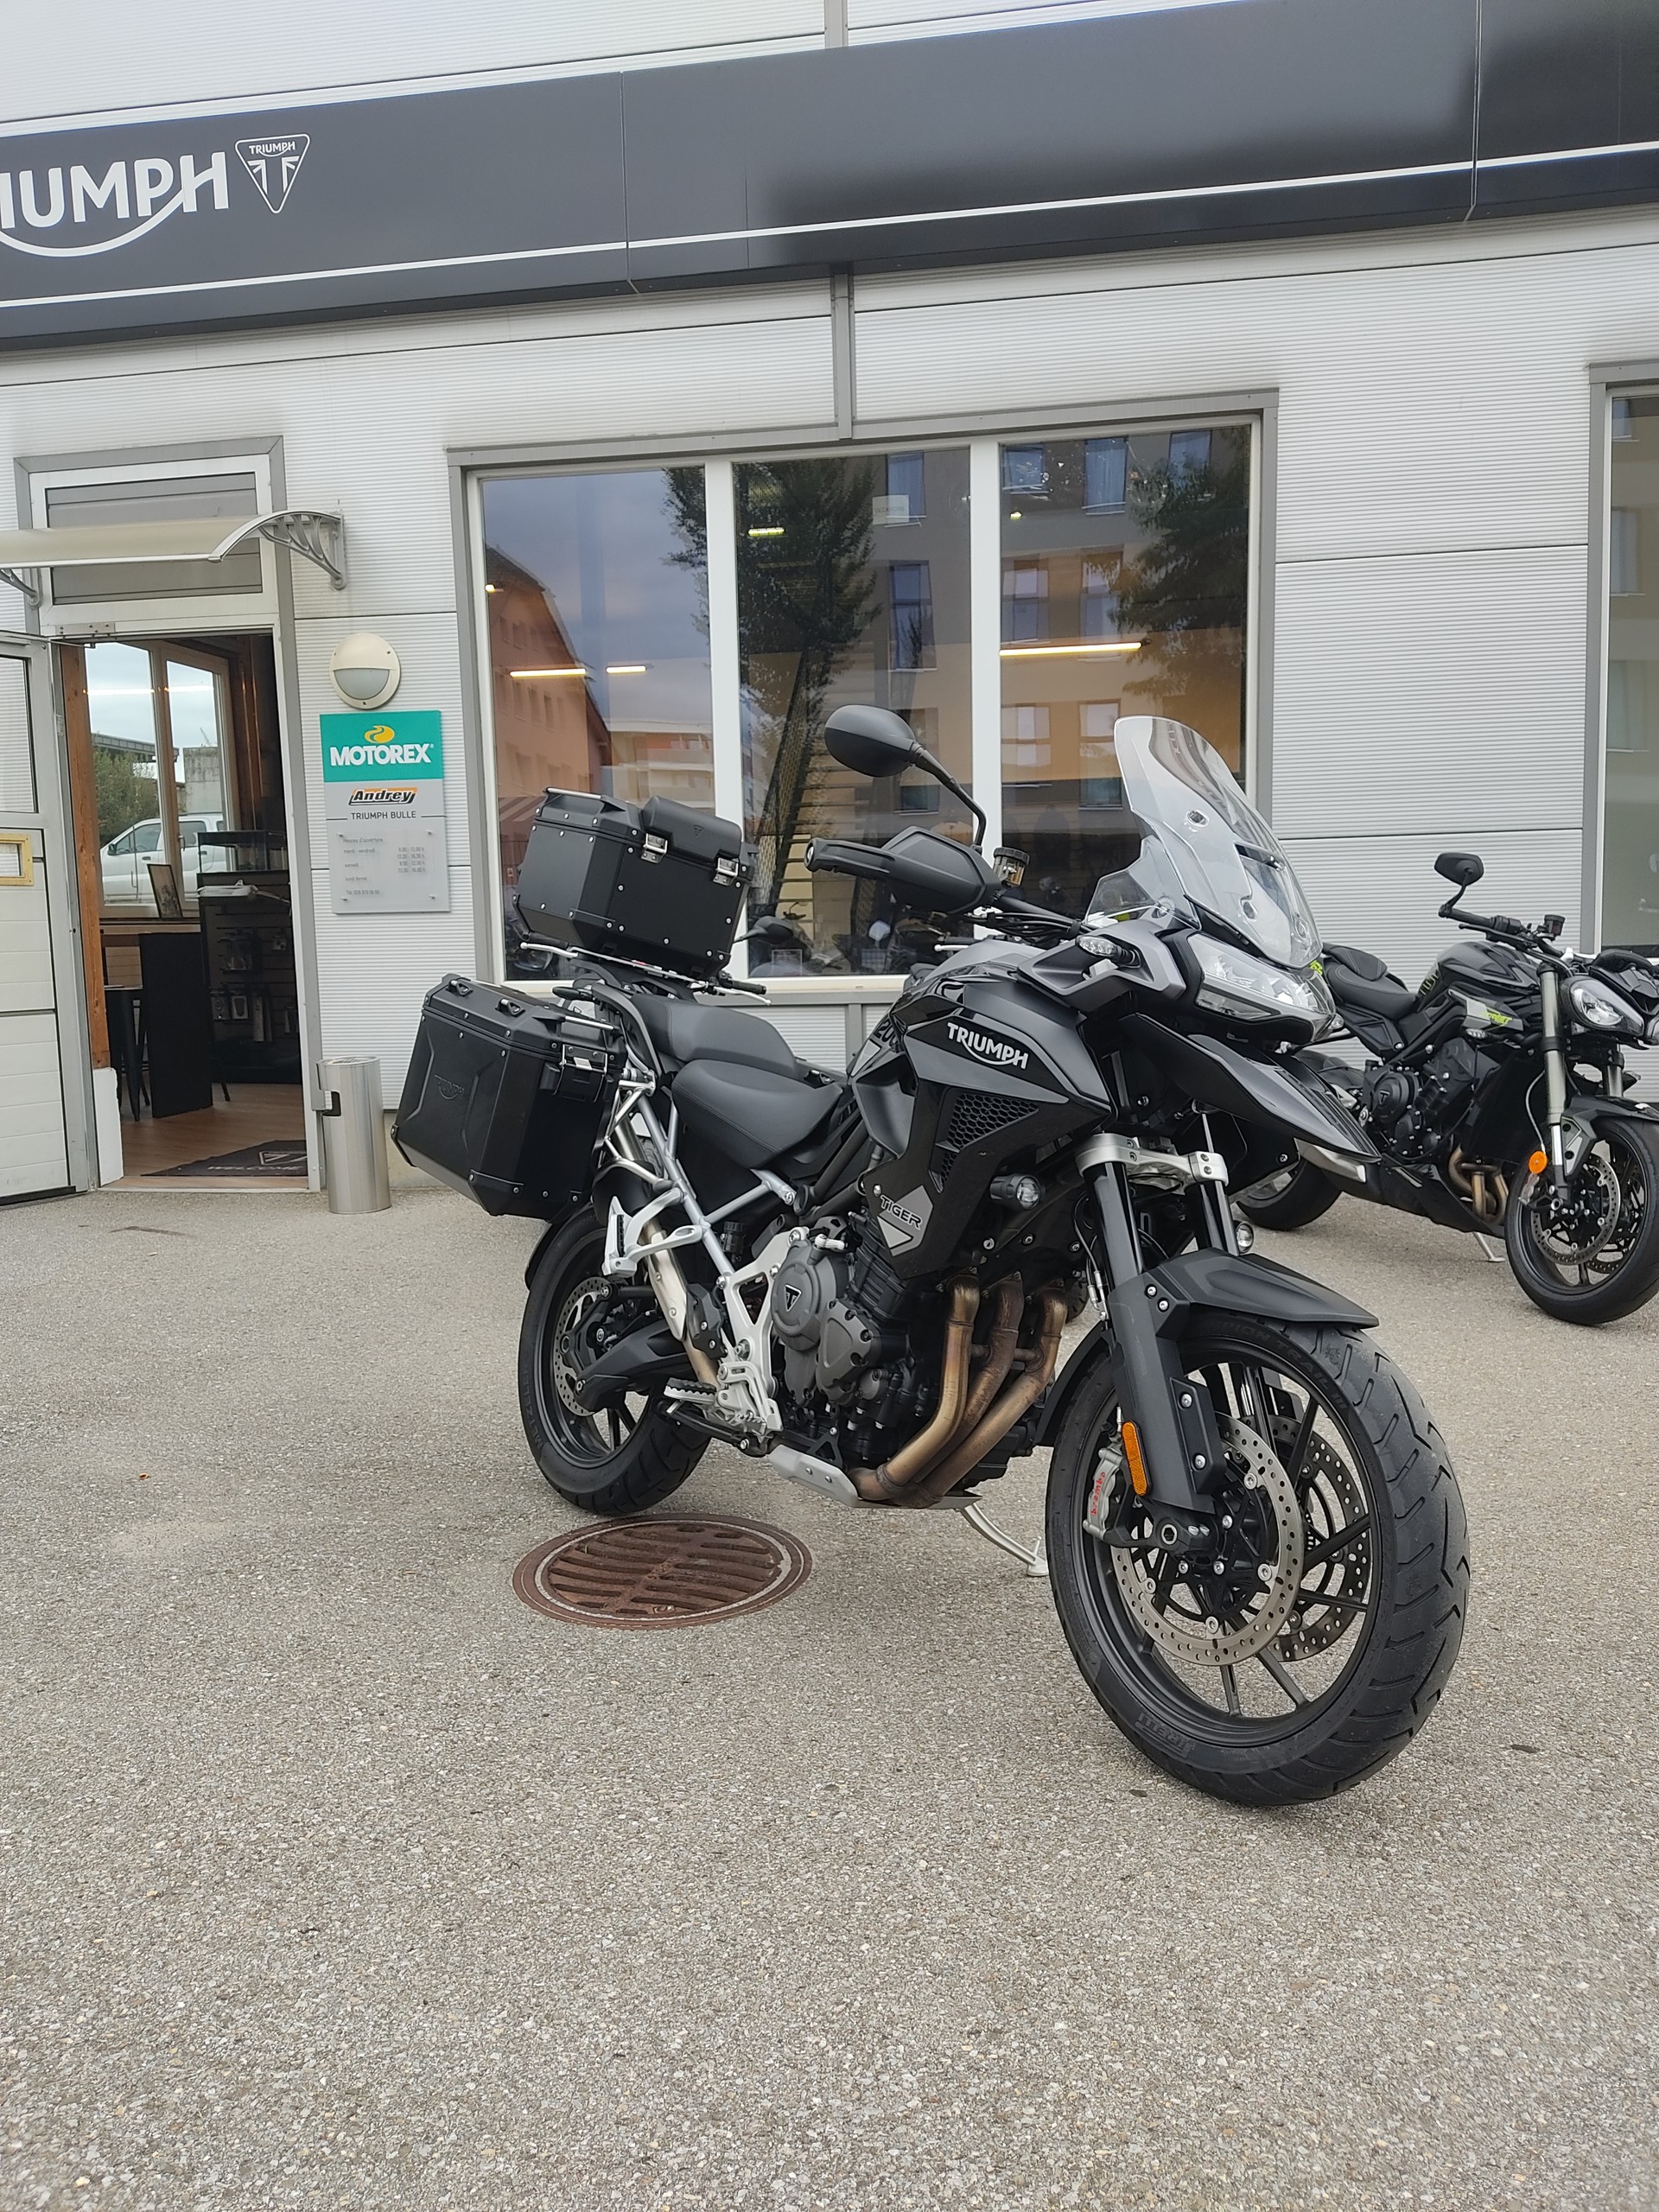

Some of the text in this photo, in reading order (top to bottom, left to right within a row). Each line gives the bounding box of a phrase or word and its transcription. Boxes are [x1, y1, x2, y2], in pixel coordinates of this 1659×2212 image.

[249, 141, 296, 156] TRIUMPH
[330, 743, 432, 766] MOTOREX
[353, 790, 413, 803] Andrey
[351, 810, 416, 820] TRIUMPH BULLE
[947, 1022, 1029, 1069] TRIUMPH
[880, 1194, 923, 1230] TIGER
[1090, 1471, 1106, 1516] brembo
